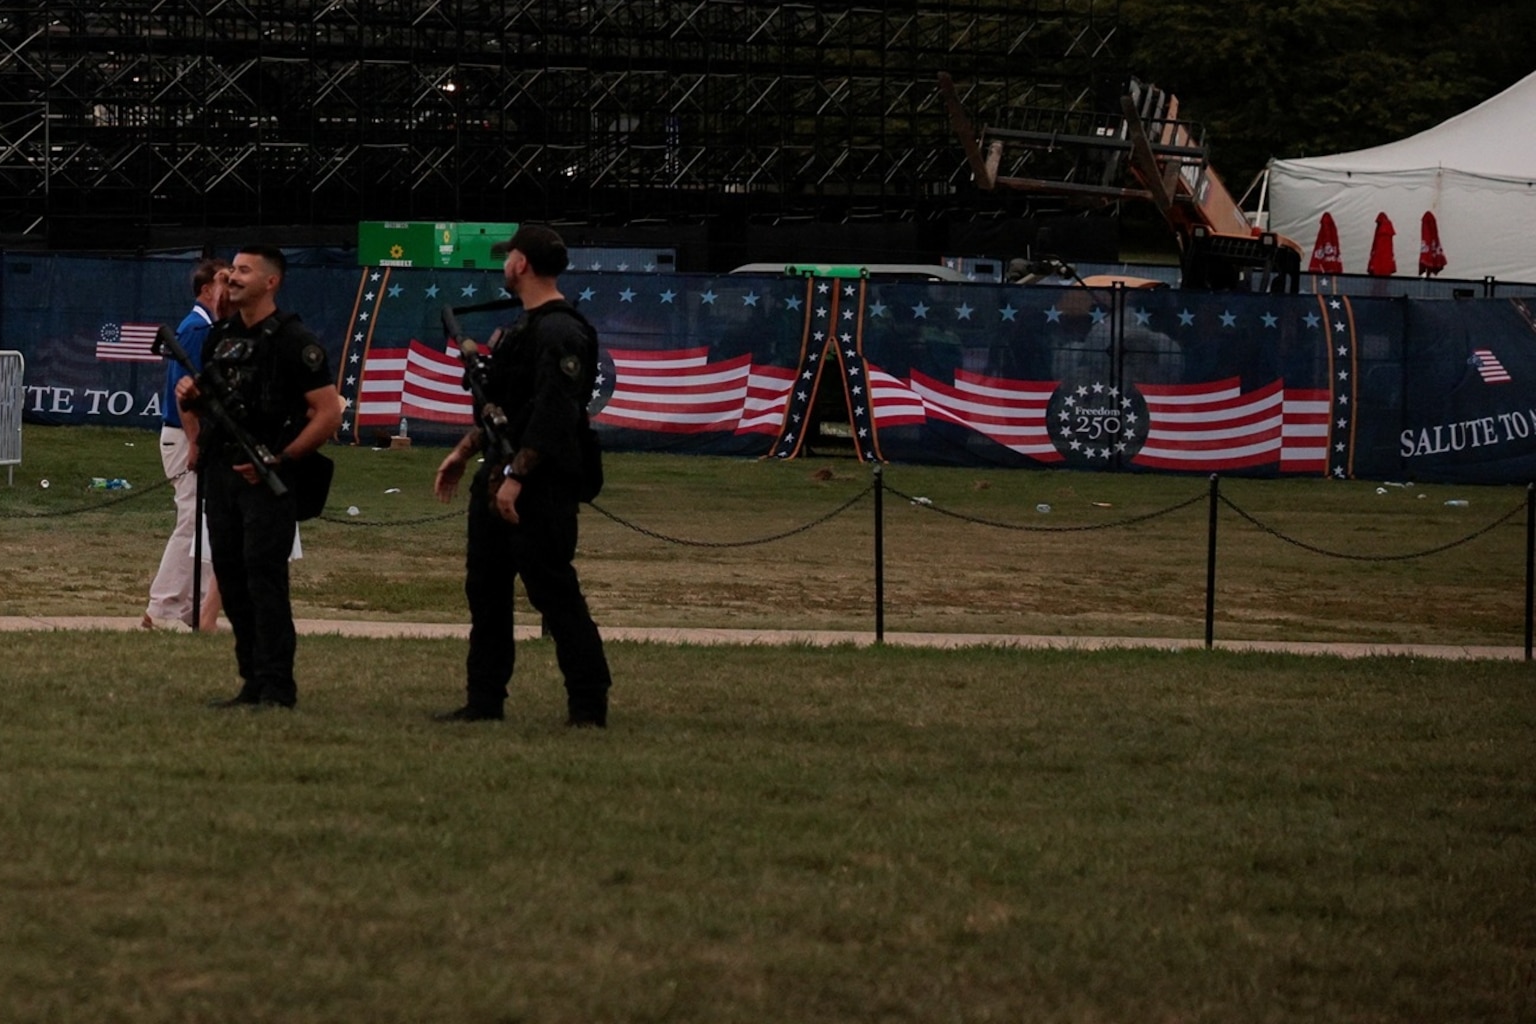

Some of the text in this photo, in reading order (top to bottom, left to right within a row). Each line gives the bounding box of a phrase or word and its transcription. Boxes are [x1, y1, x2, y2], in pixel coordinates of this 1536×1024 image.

[84, 388, 134, 416] TO
[1075, 406, 1121, 416] Freedom
[1075, 416, 1121, 439] 250
[1400, 417, 1498, 458] SALUTE
[1498, 411, 1529, 441] TO
